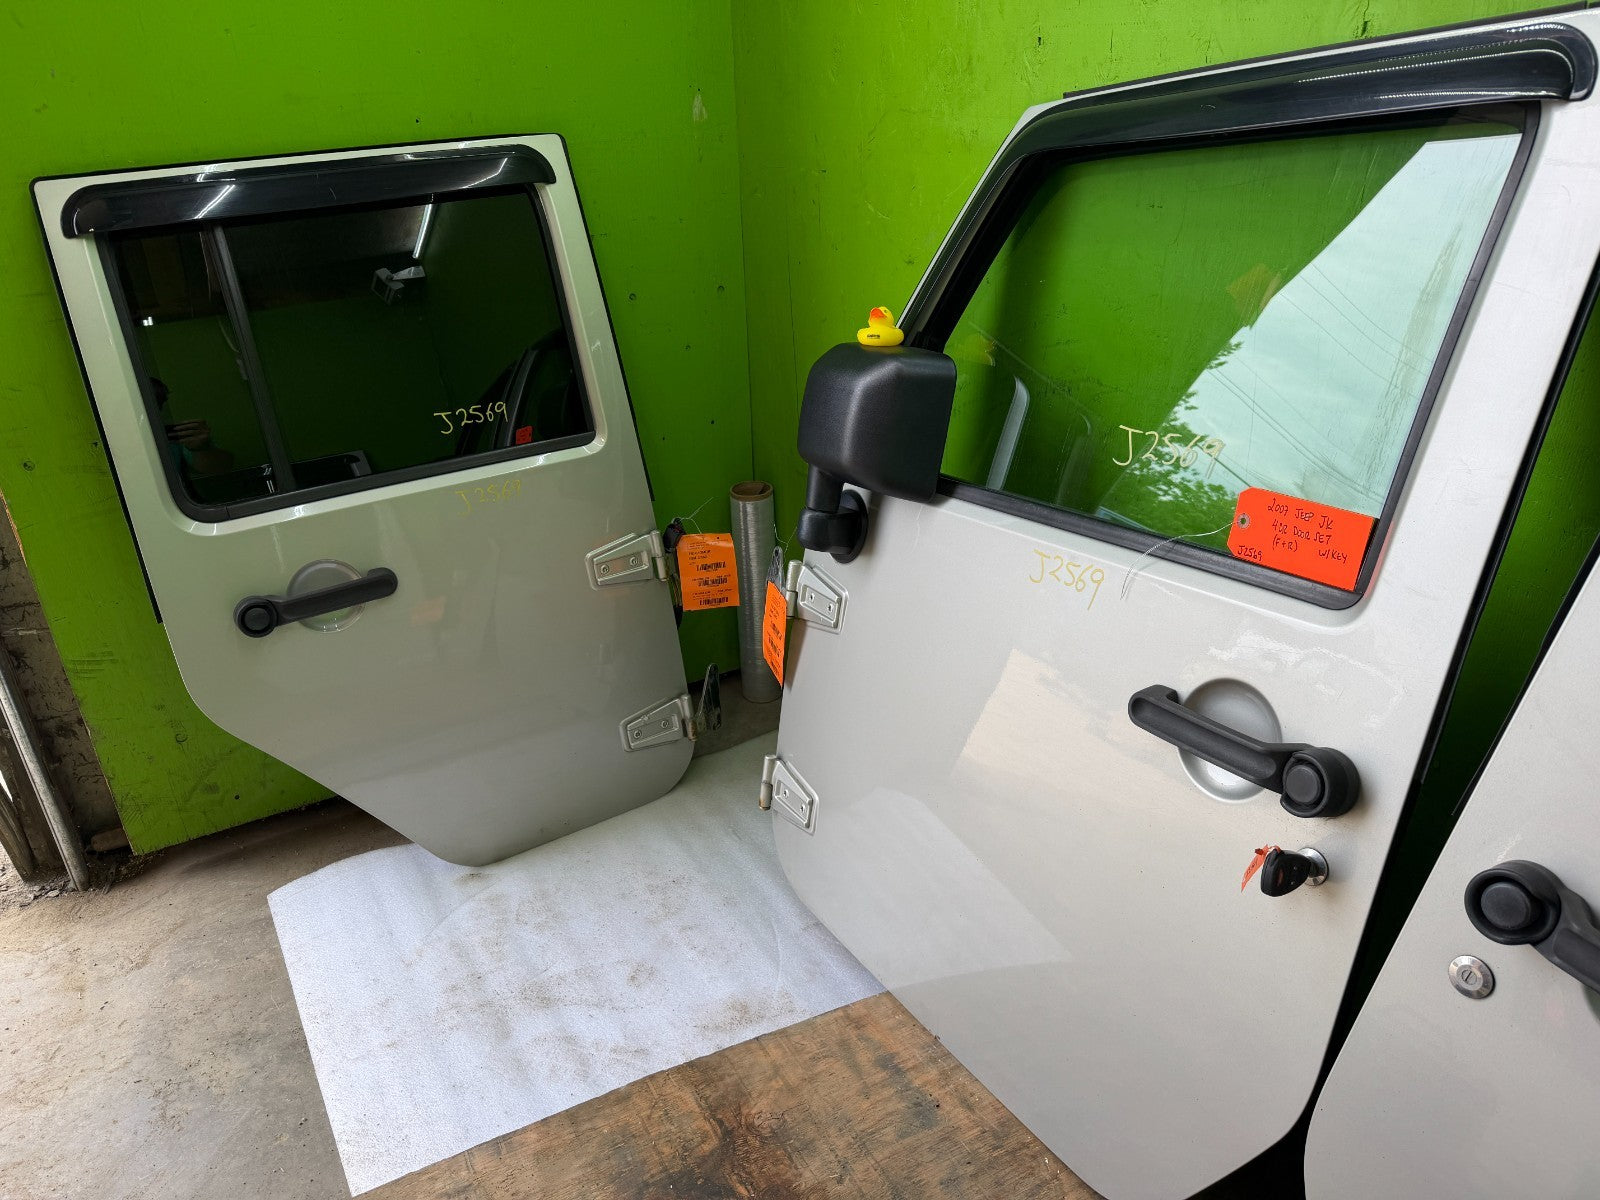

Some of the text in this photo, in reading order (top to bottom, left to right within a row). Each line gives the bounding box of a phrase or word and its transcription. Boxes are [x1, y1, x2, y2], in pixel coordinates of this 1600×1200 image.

[434, 401, 508, 434] J2569
[1112, 424, 1226, 479] J2569
[455, 479, 521, 516] J2569
[1267, 497, 1334, 530] 2007 JEEP JK
[1293, 525, 1311, 540] DOOR
[1314, 532, 1332, 545] SET
[1237, 544, 1263, 562] J2569
[1029, 548, 1105, 610] J2569
